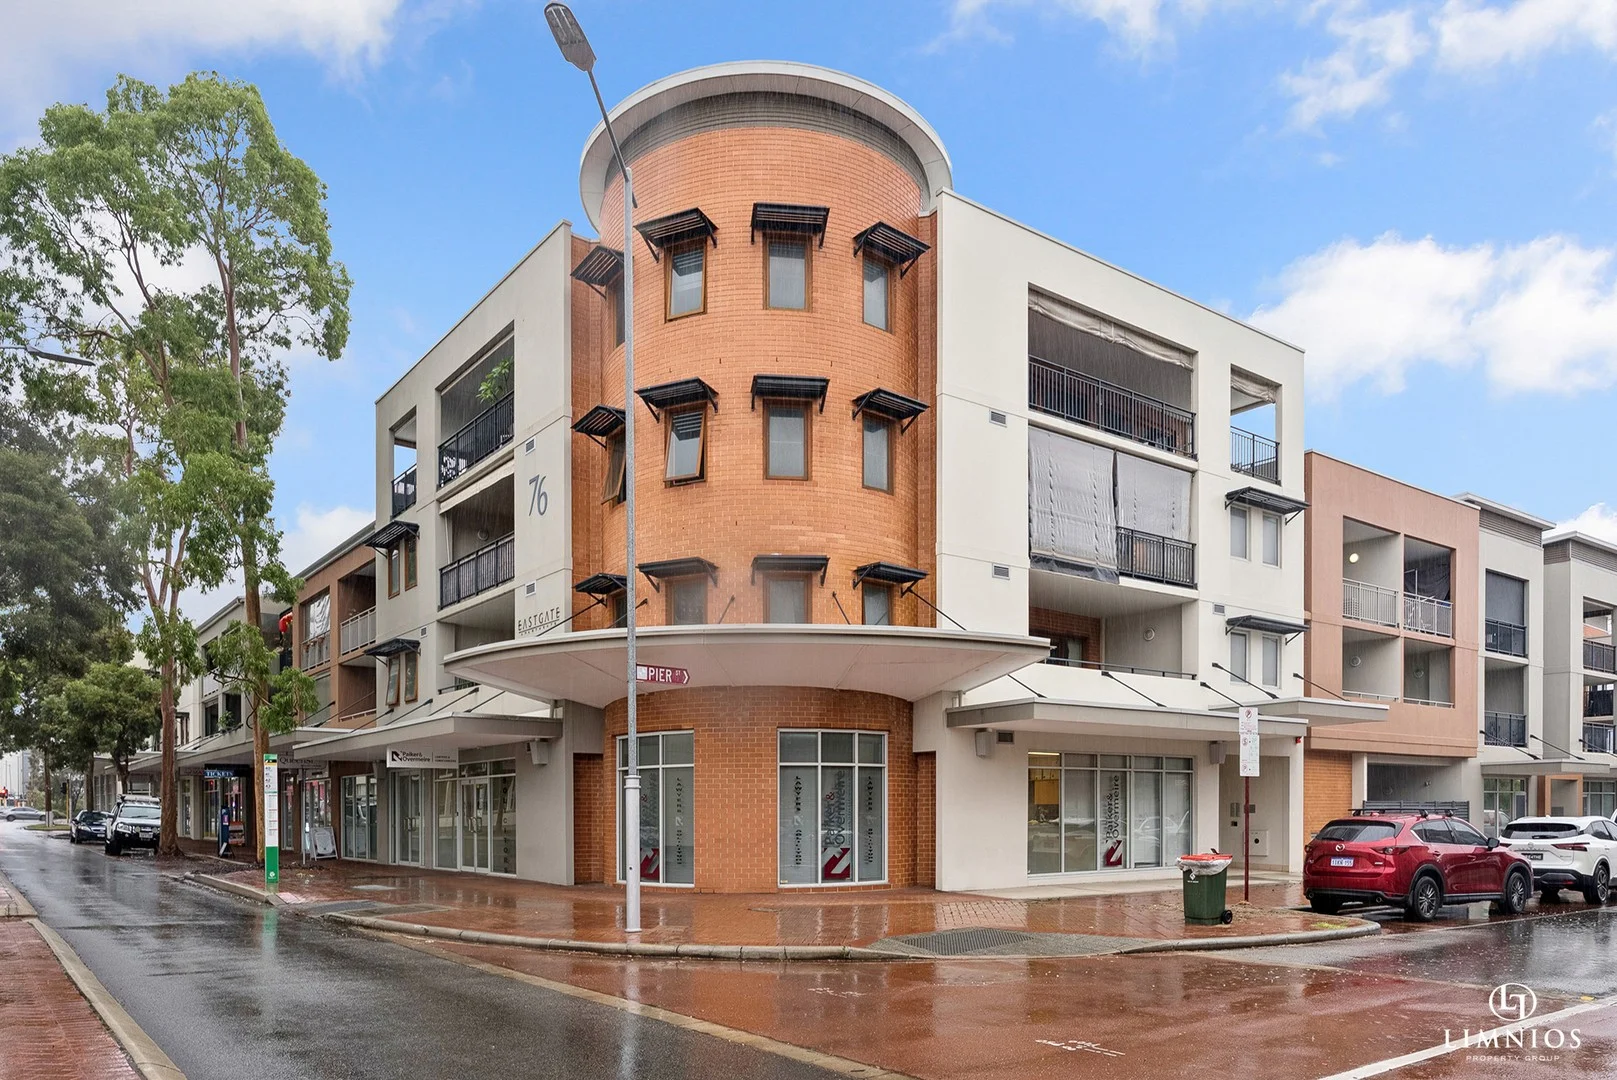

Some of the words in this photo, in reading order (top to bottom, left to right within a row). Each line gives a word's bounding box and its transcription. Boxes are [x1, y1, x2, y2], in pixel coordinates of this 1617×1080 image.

[529, 474, 548, 516] 76
[518, 607, 560, 631] EASTGATE
[648, 667, 672, 682] PIER
[826, 792, 835, 800] &
